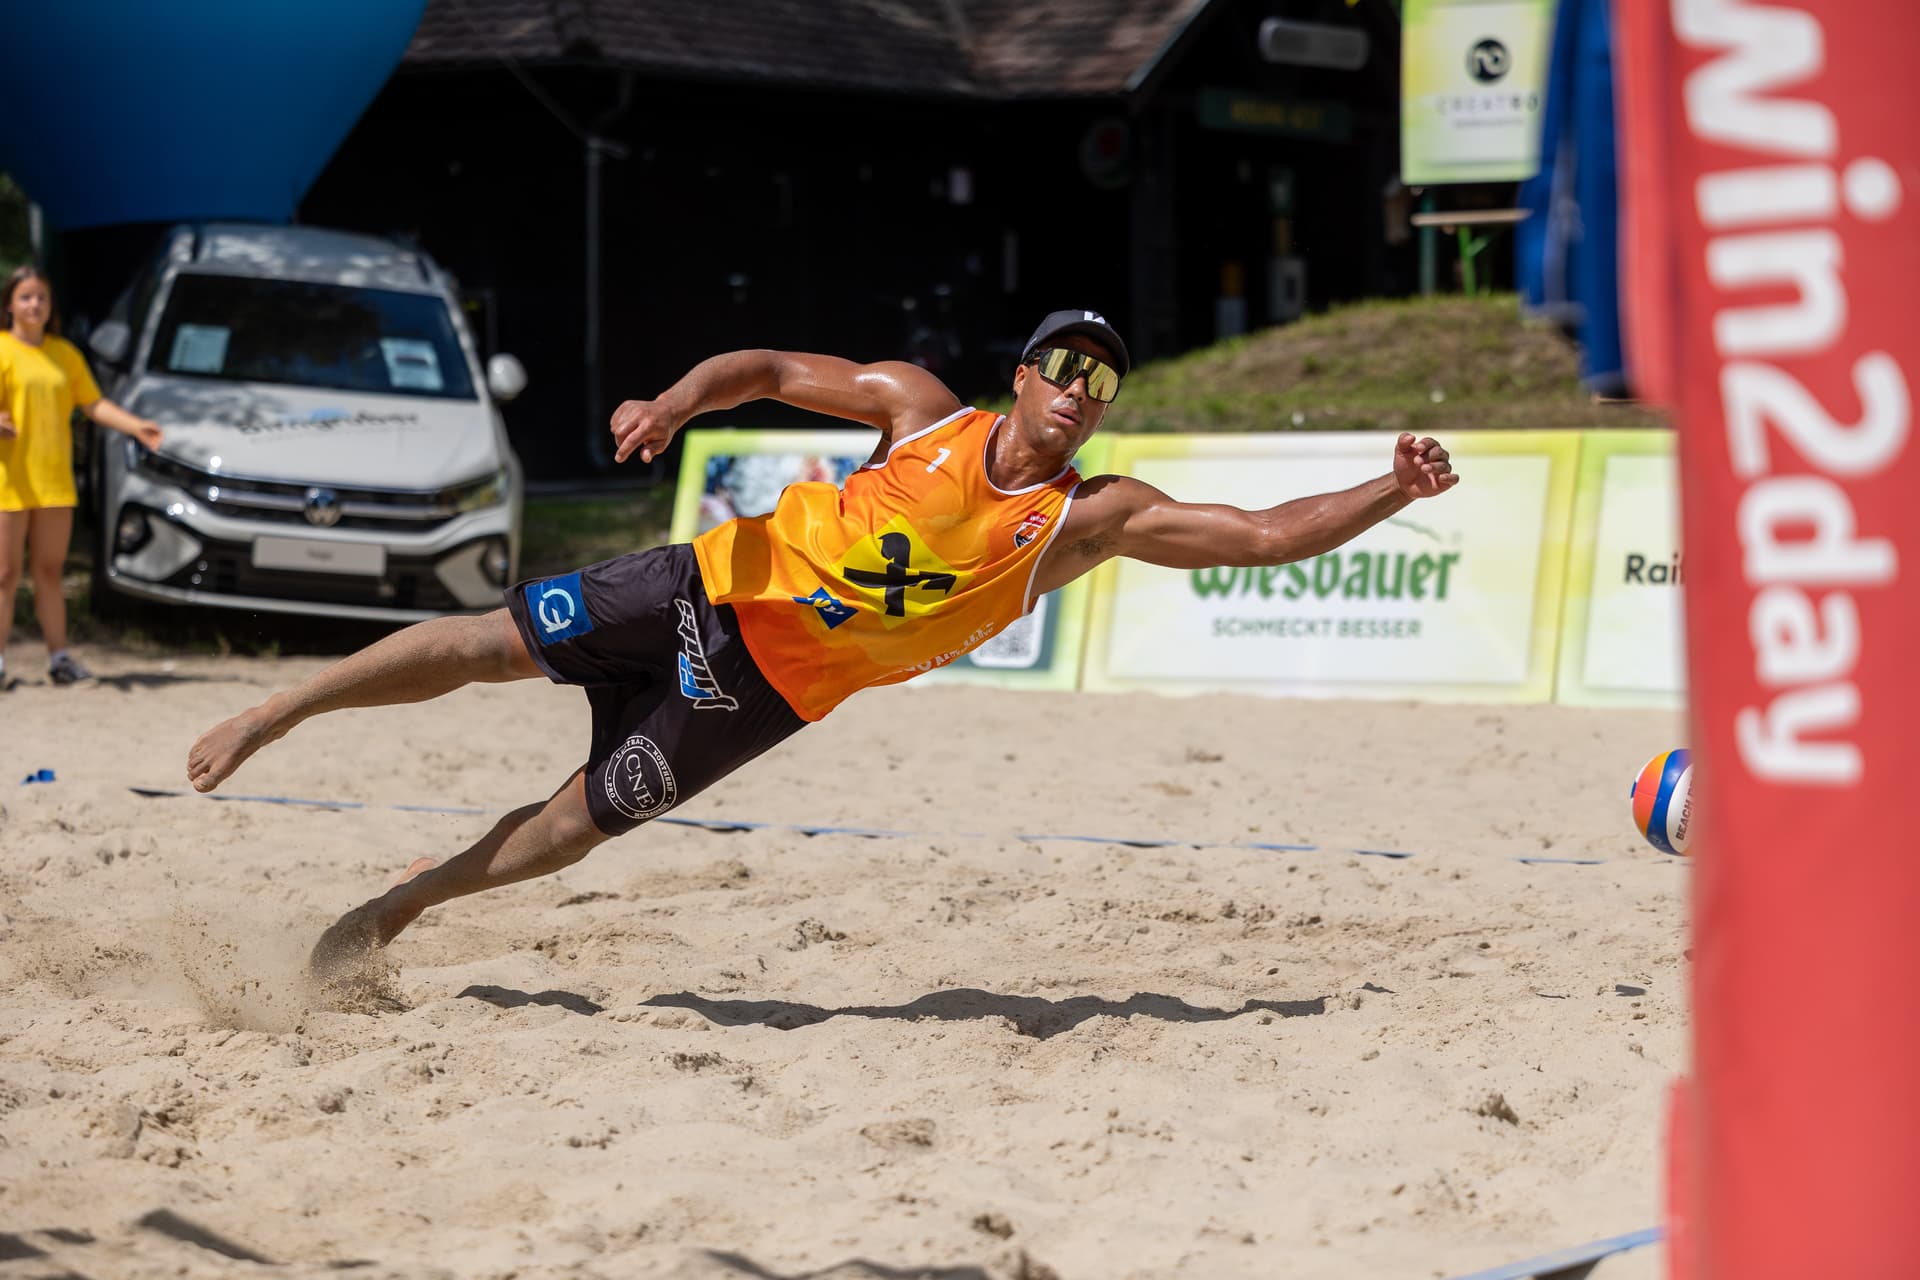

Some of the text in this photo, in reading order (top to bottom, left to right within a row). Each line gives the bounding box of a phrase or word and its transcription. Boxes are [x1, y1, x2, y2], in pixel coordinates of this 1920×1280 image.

[1671, 0, 1910, 785] win2day
[926, 447, 951, 474] 1
[1625, 551, 1686, 585] Rai
[1212, 617, 1422, 638] SCHMECKT BESSER
[607, 782, 616, 799] PRO
[626, 753, 656, 808] CNE
[1675, 799, 1694, 841] BEACH
